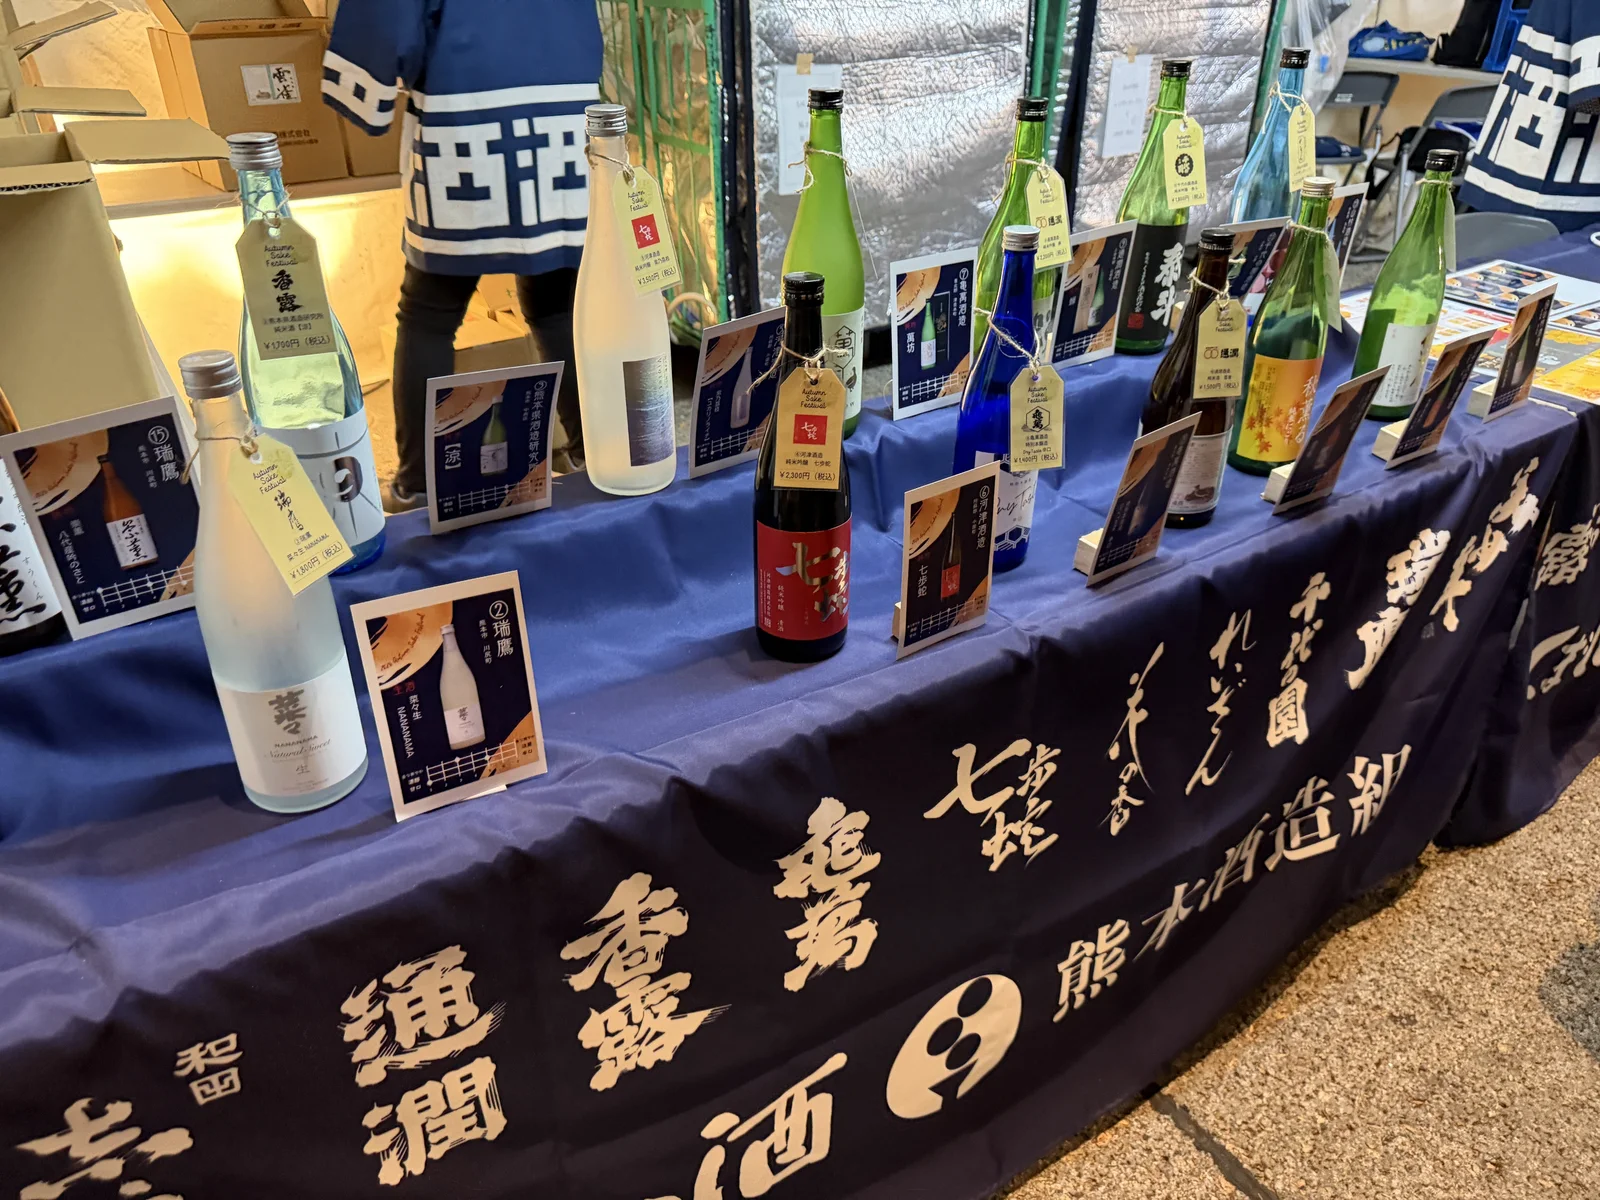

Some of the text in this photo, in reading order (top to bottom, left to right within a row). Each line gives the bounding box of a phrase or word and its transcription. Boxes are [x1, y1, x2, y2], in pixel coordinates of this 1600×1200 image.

[271, 269, 304, 313] 香露
[261, 472, 279, 485] Sake
[560, 872, 731, 1091] 香露
[340, 945, 506, 1186] 通潤
